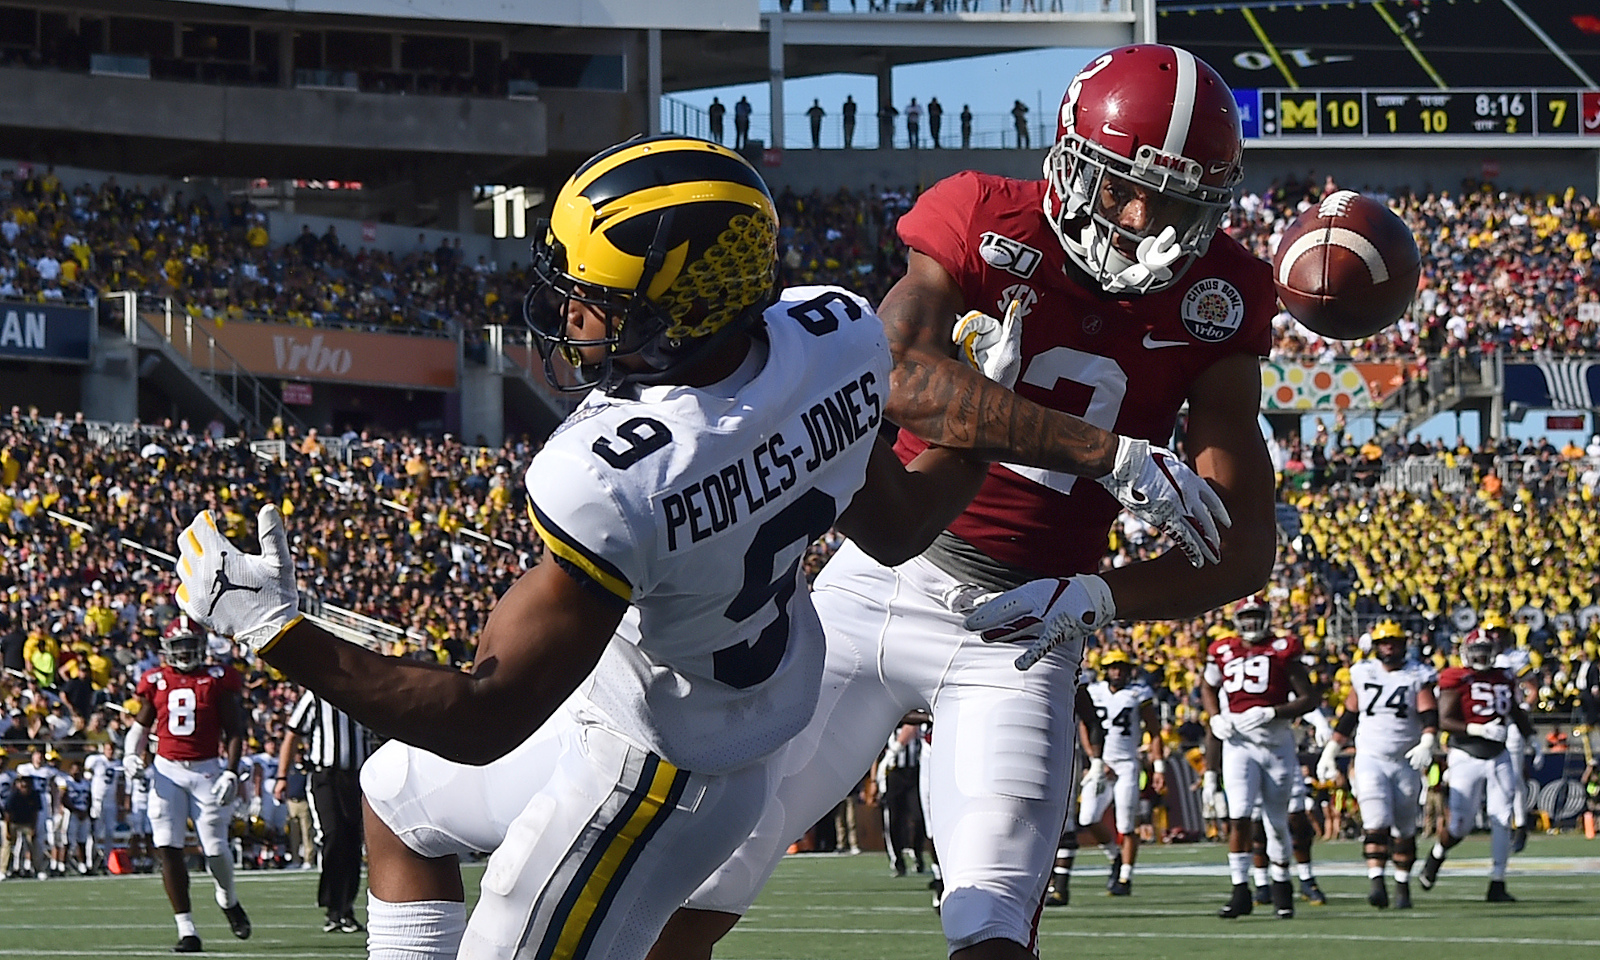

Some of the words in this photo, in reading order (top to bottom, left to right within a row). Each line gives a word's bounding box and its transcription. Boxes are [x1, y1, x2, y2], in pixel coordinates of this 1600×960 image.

[1280, 99, 1318, 129] M
[1326, 100, 1360, 128] 10
[1385, 109, 1397, 133] 1
[1419, 109, 1448, 133] 10
[1475, 94, 1525, 116] 8:16
[1548, 100, 1568, 128] 7
[1505, 116, 1518, 133] 2
[1187, 280, 1219, 303] CITRUS
[1220, 283, 1241, 311] BOWL
[1, 310, 47, 350] AN
[787, 291, 862, 337] 9
[1194, 323, 1224, 338] Vrbo
[272, 334, 353, 374] Vrbo
[592, 416, 673, 470] 9
[662, 371, 881, 551] PEOPLES-JONES
[713, 486, 837, 689] 9
[1223, 655, 1269, 693] 99
[167, 688, 196, 736] 8
[1364, 683, 1409, 718] 74
